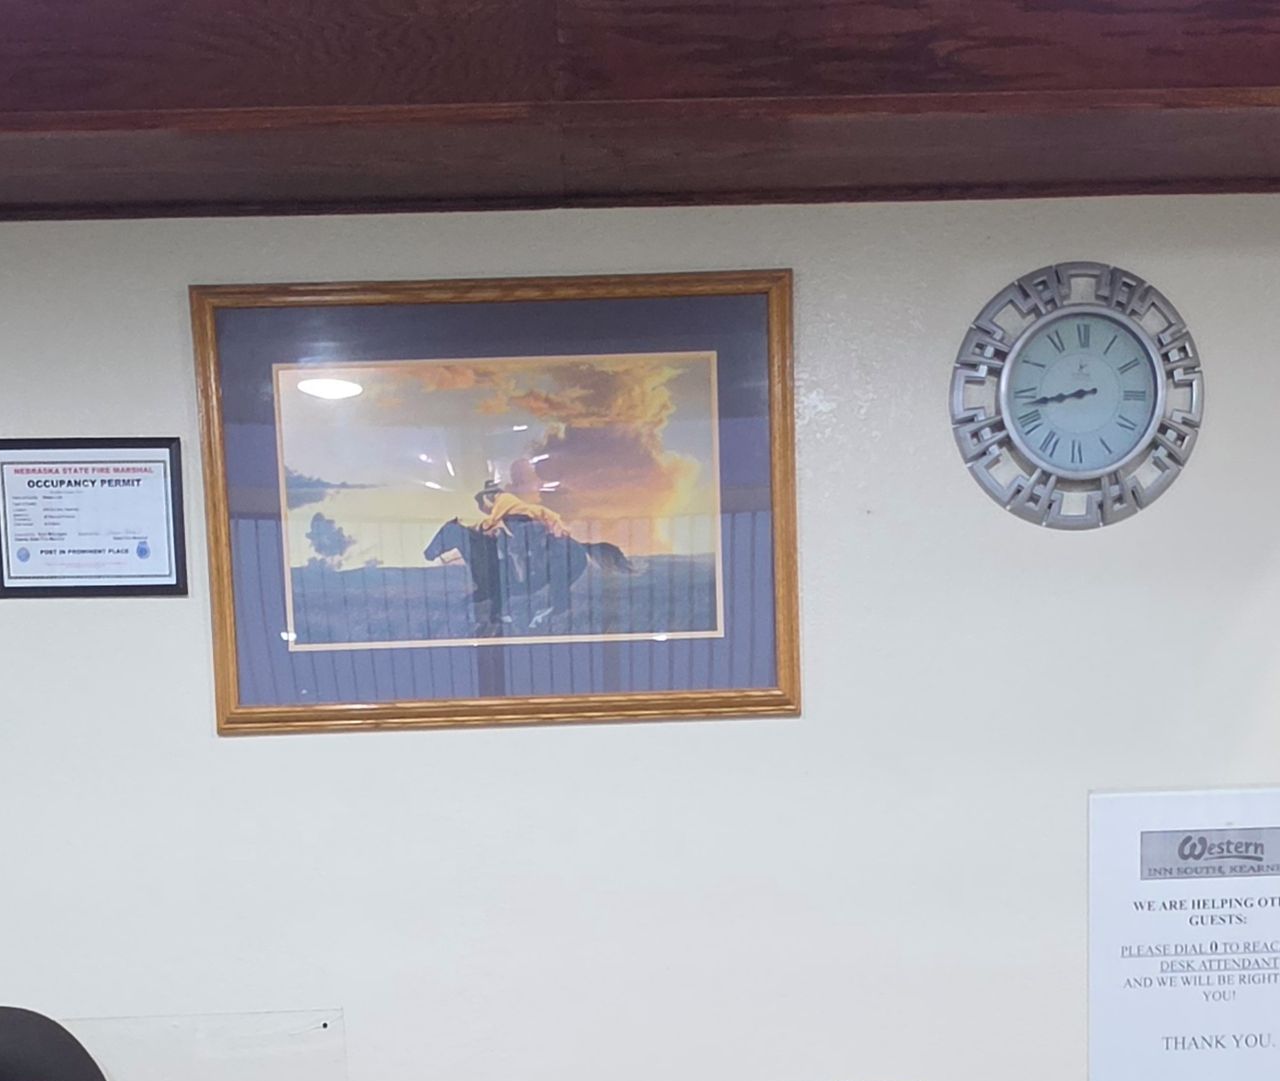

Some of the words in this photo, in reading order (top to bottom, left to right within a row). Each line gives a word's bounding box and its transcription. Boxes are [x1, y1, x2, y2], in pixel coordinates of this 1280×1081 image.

[27, 479, 96, 488] OCCUPANCY
[100, 479, 142, 487] PERMIT
[1177, 835, 1265, 861] Western
[1148, 866, 1173, 877] INN
[1134, 901, 1156, 911] WE
[1159, 900, 1188, 911] ARE
[1191, 898, 1255, 910] HELPING
[1189, 915, 1248, 926] GUESTS:
[1121, 944, 1171, 957] PLEASE
[1175, 943, 1207, 956] DIAL
[1222, 942, 1240, 955] TO
[1160, 959, 1196, 972] DESK
[1201, 957, 1279, 971] ATTENDANT
[1123, 977, 1153, 988] AND
[1156, 977, 1177, 988] WE
[1180, 975, 1215, 987] WILL
[1218, 975, 1235, 986] BE
[1238, 973, 1280, 985] RIGHT
[1202, 990, 1236, 1002] YOU!
[1161, 1035, 1226, 1051] THANK
[1232, 1034, 1275, 1049] YOU.
